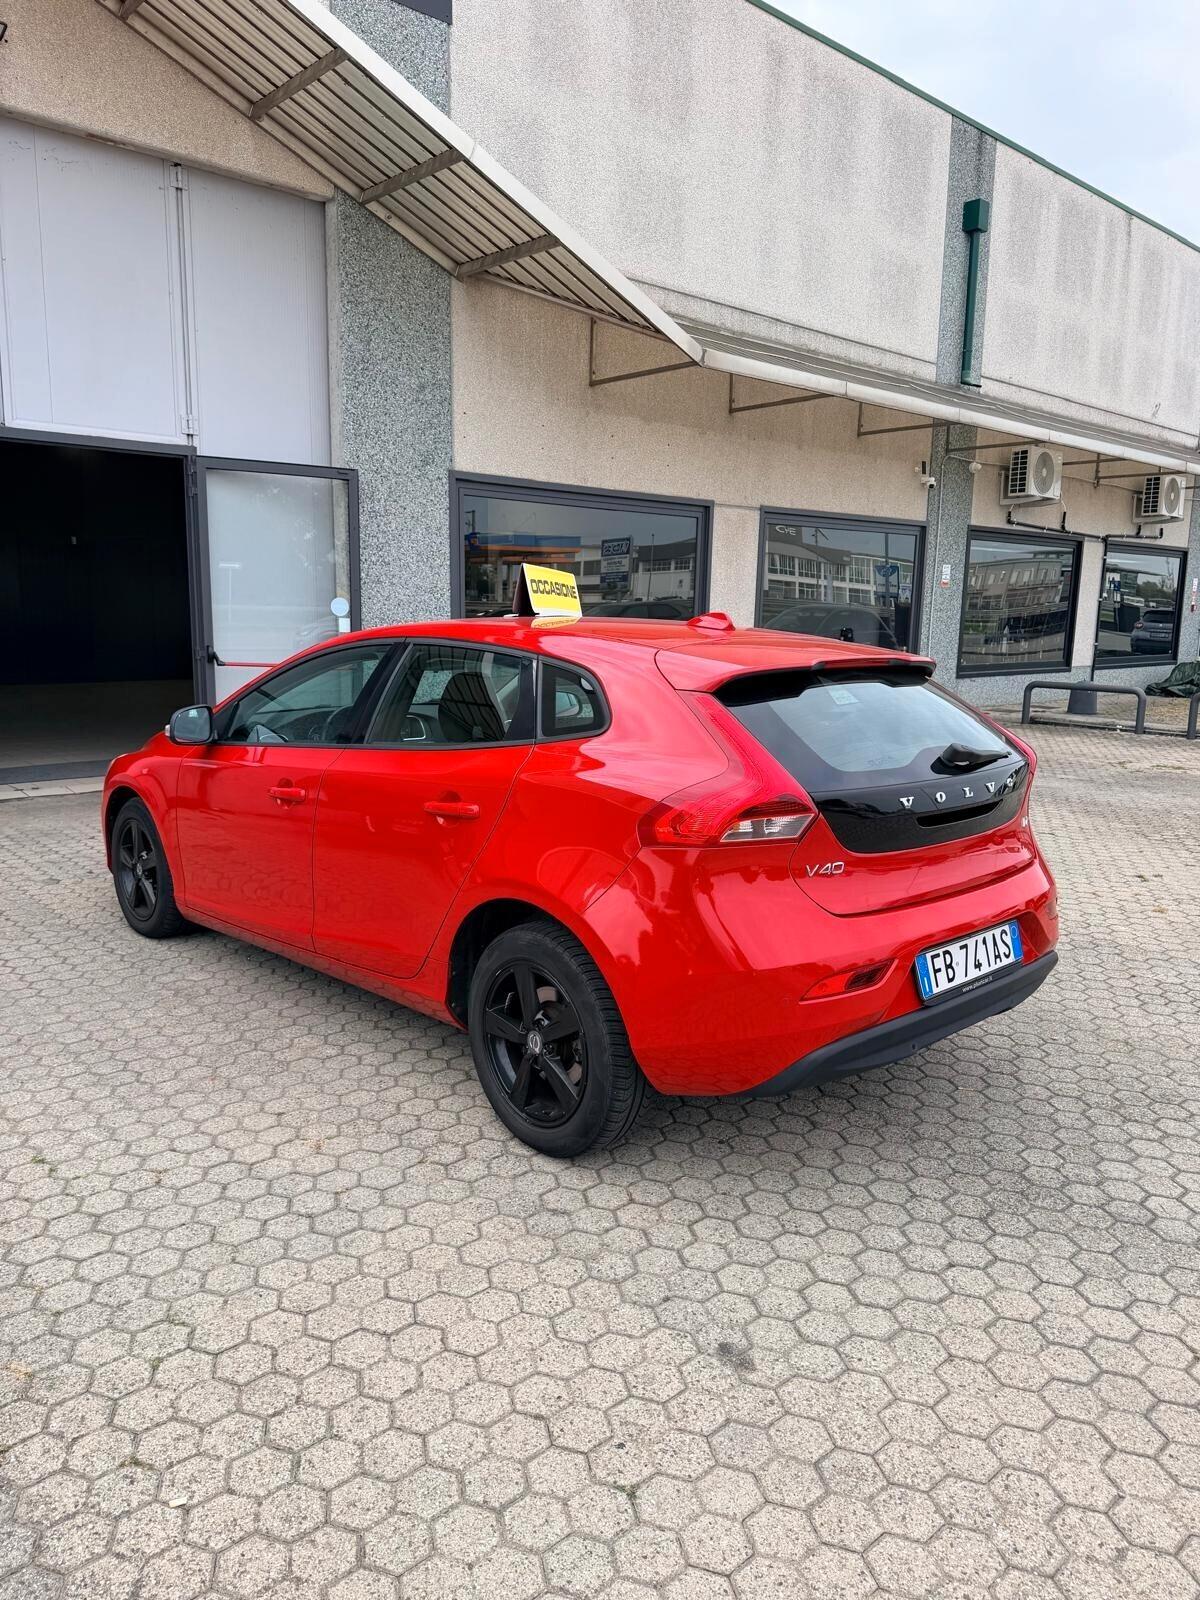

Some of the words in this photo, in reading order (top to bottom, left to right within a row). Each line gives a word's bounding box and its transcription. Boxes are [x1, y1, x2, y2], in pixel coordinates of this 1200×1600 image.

[530, 578, 578, 600] OCCASIONE
[899, 774, 1015, 809] VOLVO
[806, 861, 845, 877] V40
[930, 949, 956, 988] FB
[960, 928, 1012, 978] 741AS
